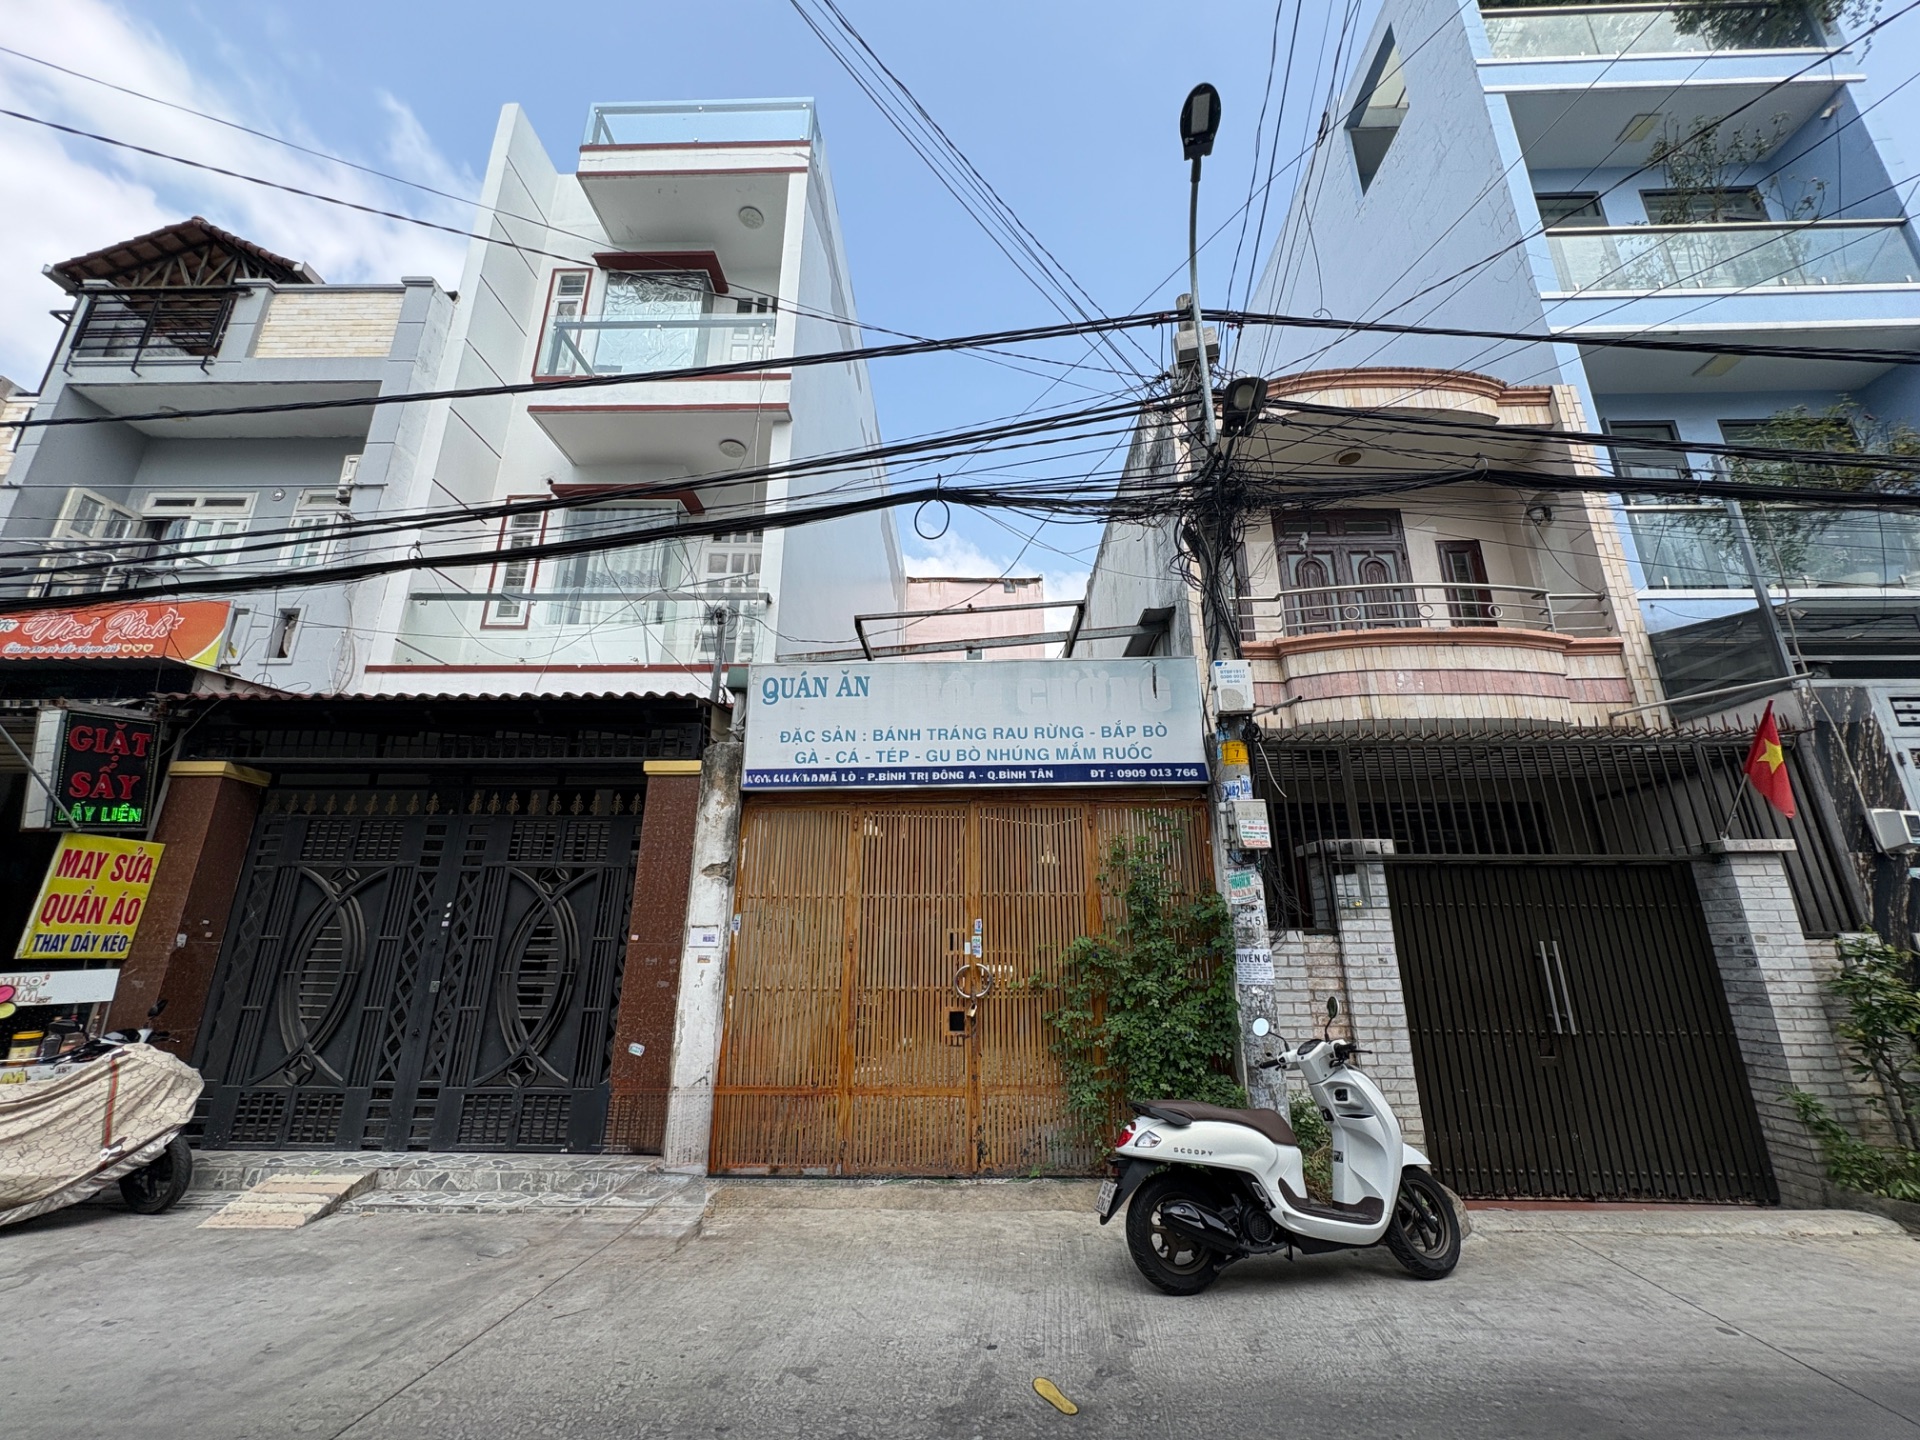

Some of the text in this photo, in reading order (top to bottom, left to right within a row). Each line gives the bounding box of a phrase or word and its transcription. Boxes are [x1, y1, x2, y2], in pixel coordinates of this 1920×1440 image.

[762, 670, 870, 705] QUÁN ĂN
[68, 722, 152, 761] GIẶT
[780, 727, 815, 746] ĐẶC
[821, 725, 857, 743] SẢN
[873, 726, 921, 742] BÁNH
[927, 725, 987, 741] TRÁNG
[993, 727, 1028, 740] RAU
[1034, 723, 1084, 740] RỪNG
[1101, 720, 1137, 738] BẮP
[1142, 722, 1168, 738] BÒ
[794, 748, 819, 765] GÀ
[836, 748, 859, 764] CÁ
[876, 747, 909, 763] TÉP
[926, 749, 951, 763] GU
[956, 746, 981, 762] BÒ
[987, 745, 1050, 761] NHÚNG
[1056, 742, 1096, 760] MẮM
[1103, 742, 1153, 760] RUỐC
[68, 763, 141, 800] SẤY
[842, 771, 856, 782] LÒ
[868, 770, 906, 781] P.BÌNH
[909, 771, 929, 783] TRỊ
[932, 769, 964, 780] ĐÔNG
[969, 771, 977, 780] A
[987, 769, 1027, 781] Q.BÌNH
[1029, 769, 1054, 779] TÂN
[1090, 770, 1106, 779] ĐT
[1117, 769, 1147, 779] 0909
[1150, 768, 1172, 778] 013
[1176, 767, 1198, 777] 766
[55, 846, 154, 883] MAY SỬA
[40, 885, 142, 926] QUẦN ÁO
[32, 931, 129, 953] THAY DÂY KÉO
